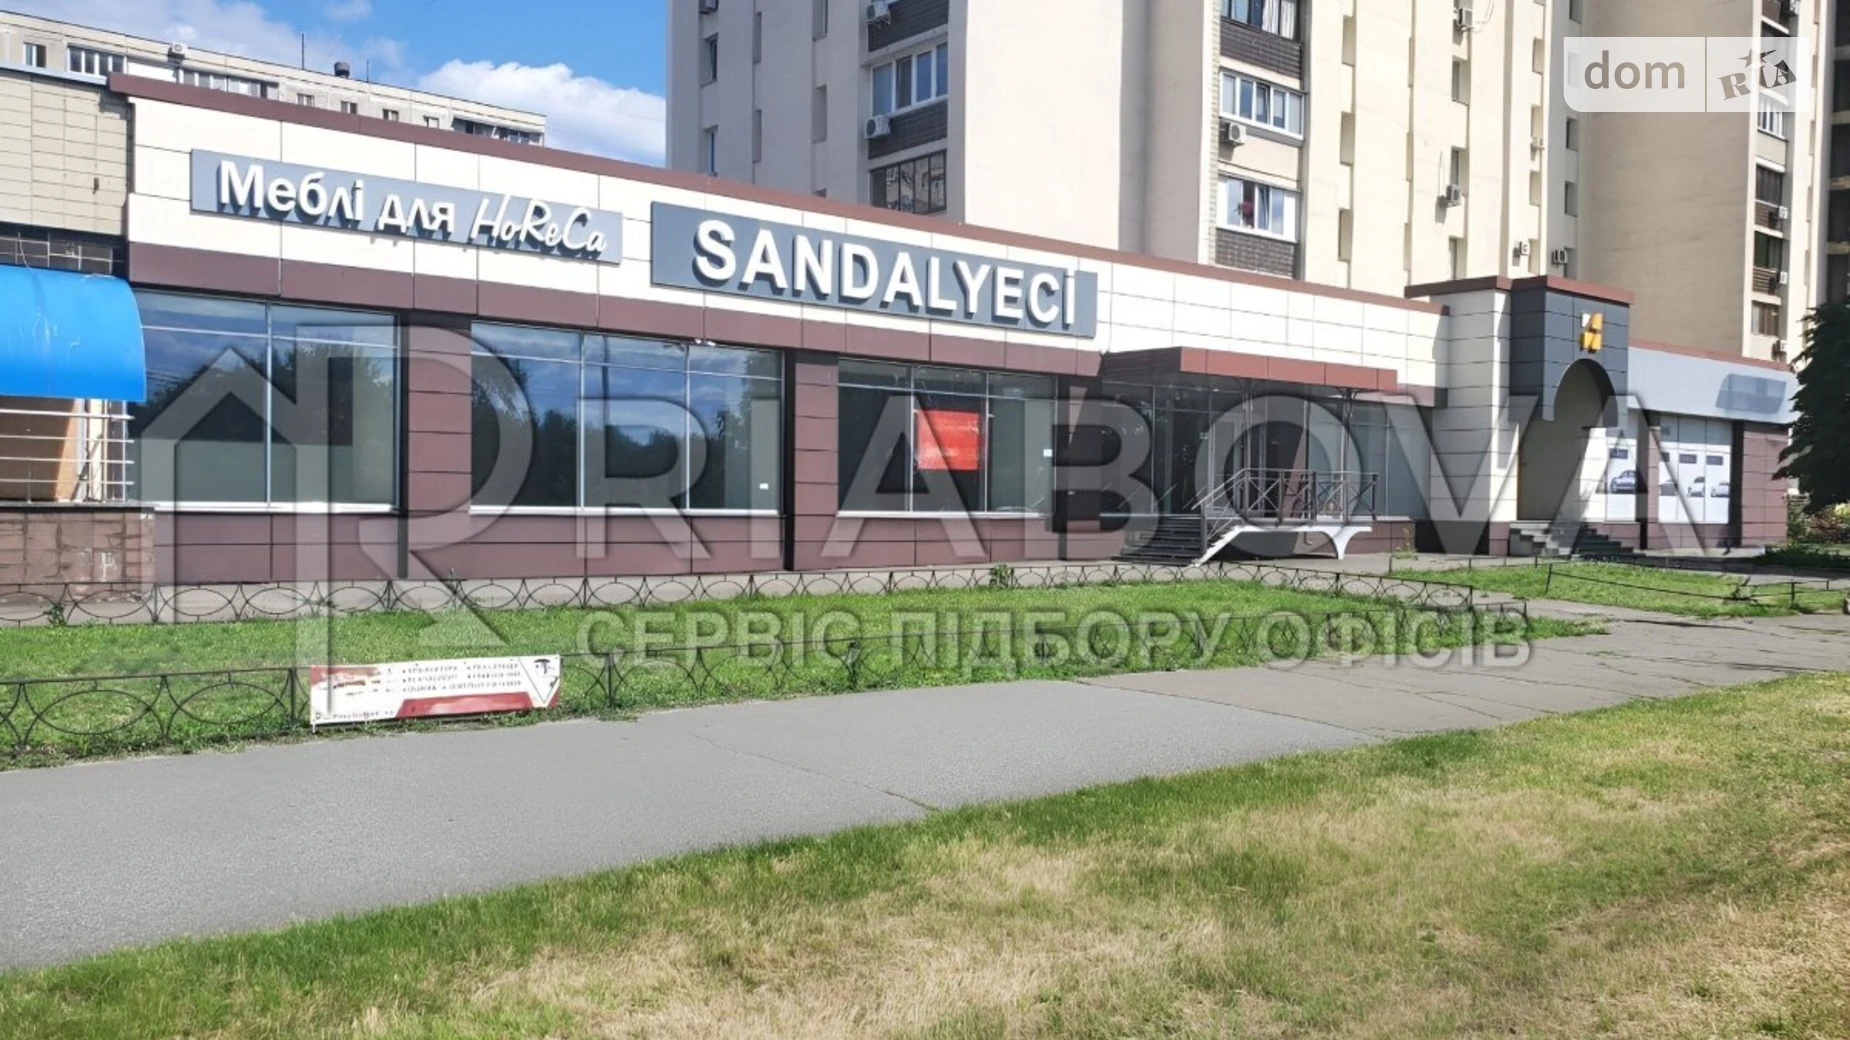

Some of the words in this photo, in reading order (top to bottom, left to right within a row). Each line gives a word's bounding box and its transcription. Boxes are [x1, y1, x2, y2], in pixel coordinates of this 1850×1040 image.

[219, 160, 364, 221] Меблі
[378, 194, 455, 234] для
[468, 194, 608, 252] HoReCa
